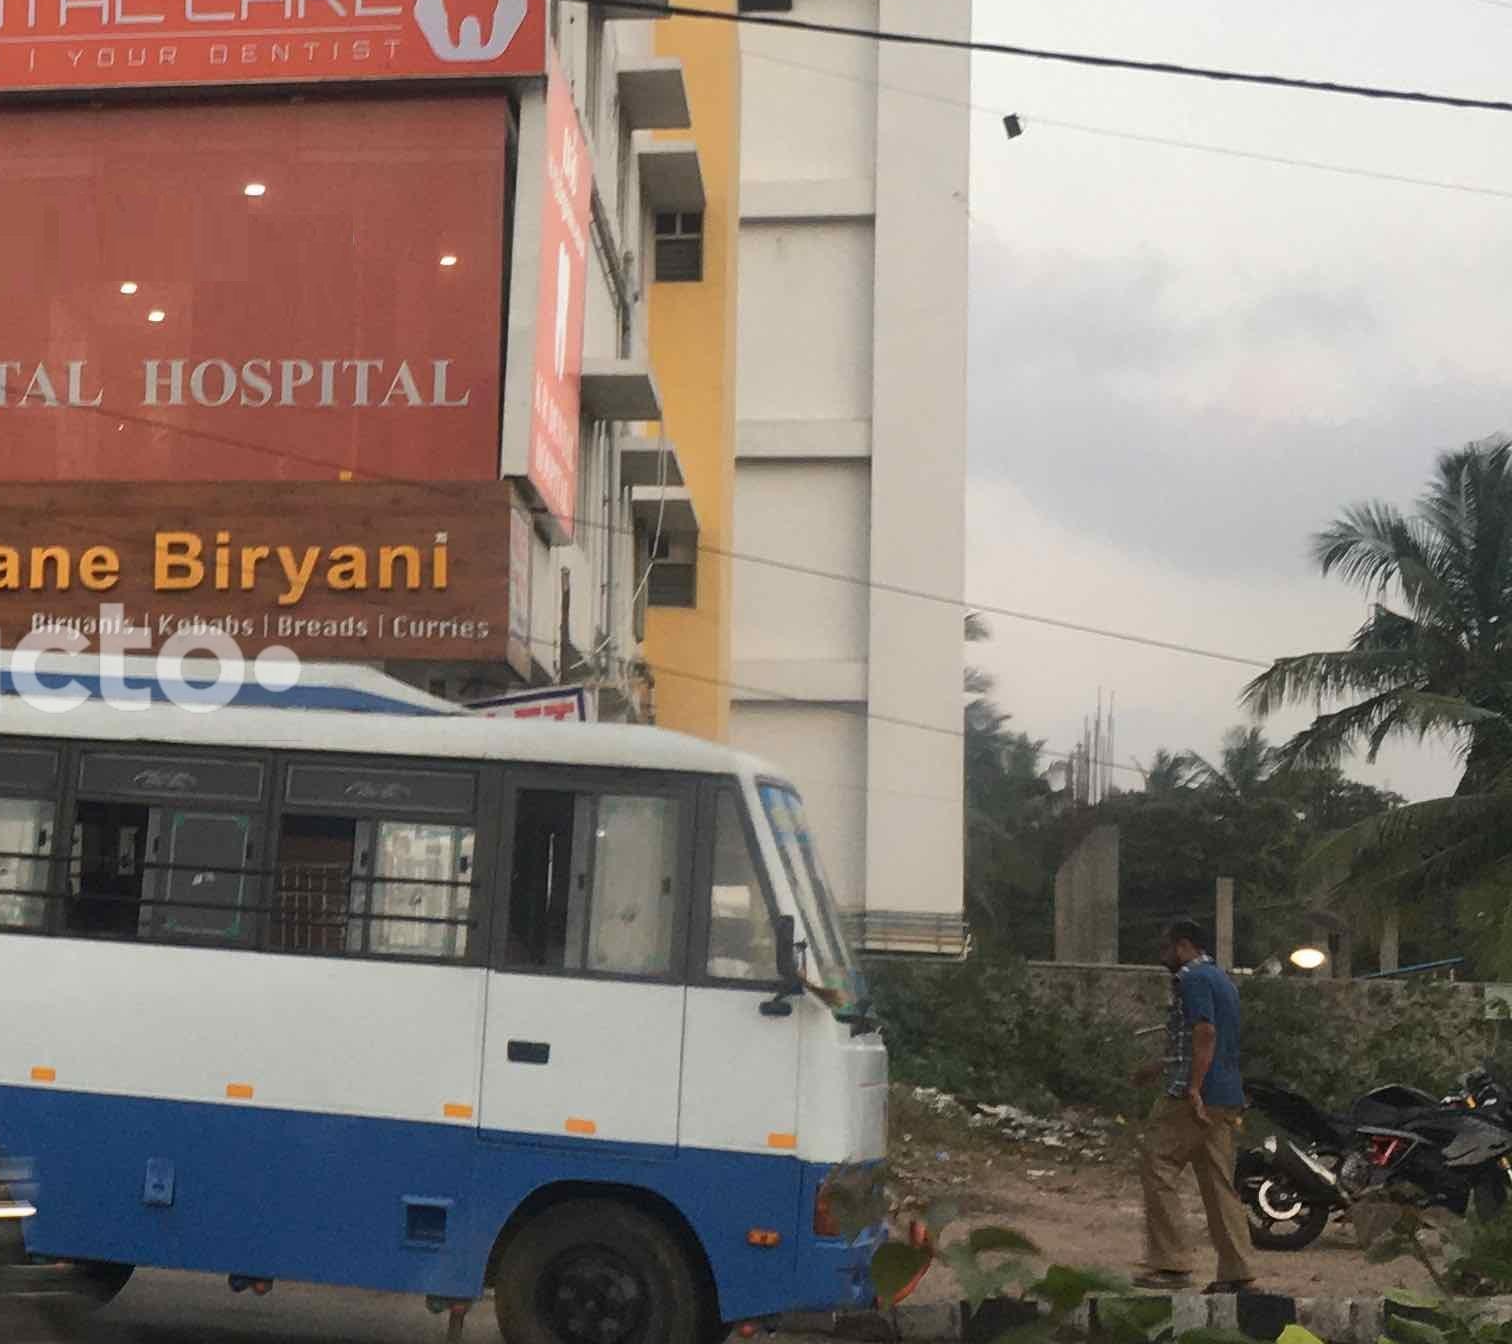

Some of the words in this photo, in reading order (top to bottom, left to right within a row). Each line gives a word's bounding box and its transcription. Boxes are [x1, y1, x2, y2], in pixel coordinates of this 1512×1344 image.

[67, 44, 177, 69] YOUR
[210, 38, 402, 64] DENTIST
[142, 357, 471, 409] HOSPITAL
[153, 530, 450, 605] Biryani
[30, 612, 135, 640] Biryanis
[157, 613, 254, 637] Kebabs
[277, 611, 369, 636] Breads
[392, 613, 489, 639] Curries
